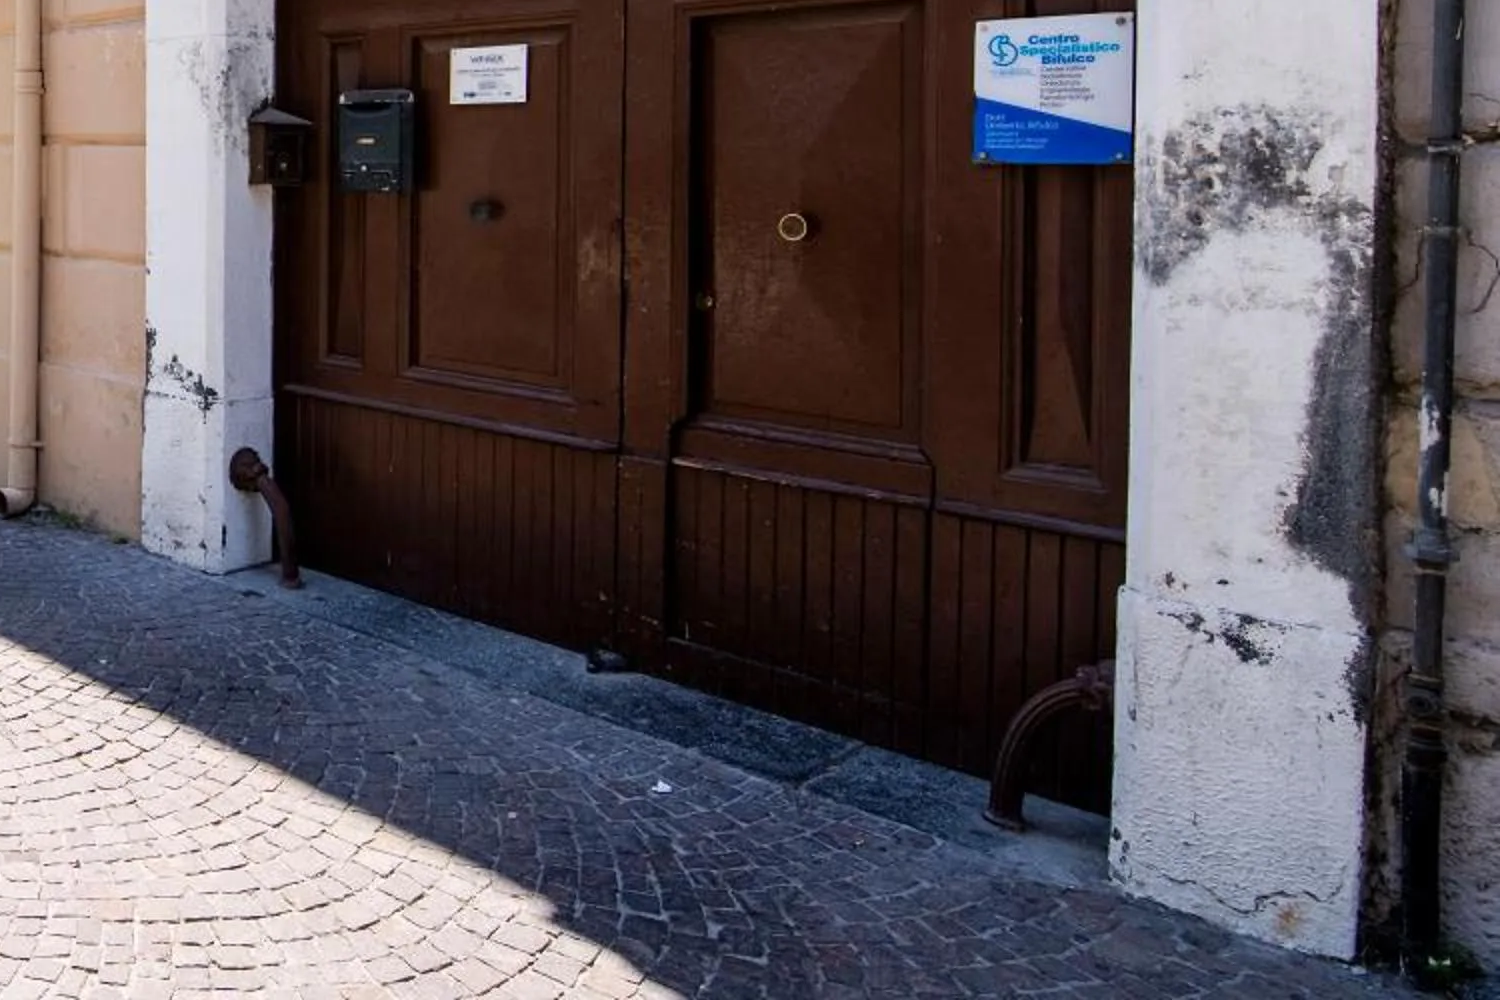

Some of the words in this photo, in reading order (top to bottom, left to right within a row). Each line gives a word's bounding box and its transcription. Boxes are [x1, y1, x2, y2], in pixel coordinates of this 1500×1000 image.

[1027, 33, 1080, 45] Centro
[1019, 42, 1121, 57] Specialistico
[1041, 54, 1096, 65] Bifulco
